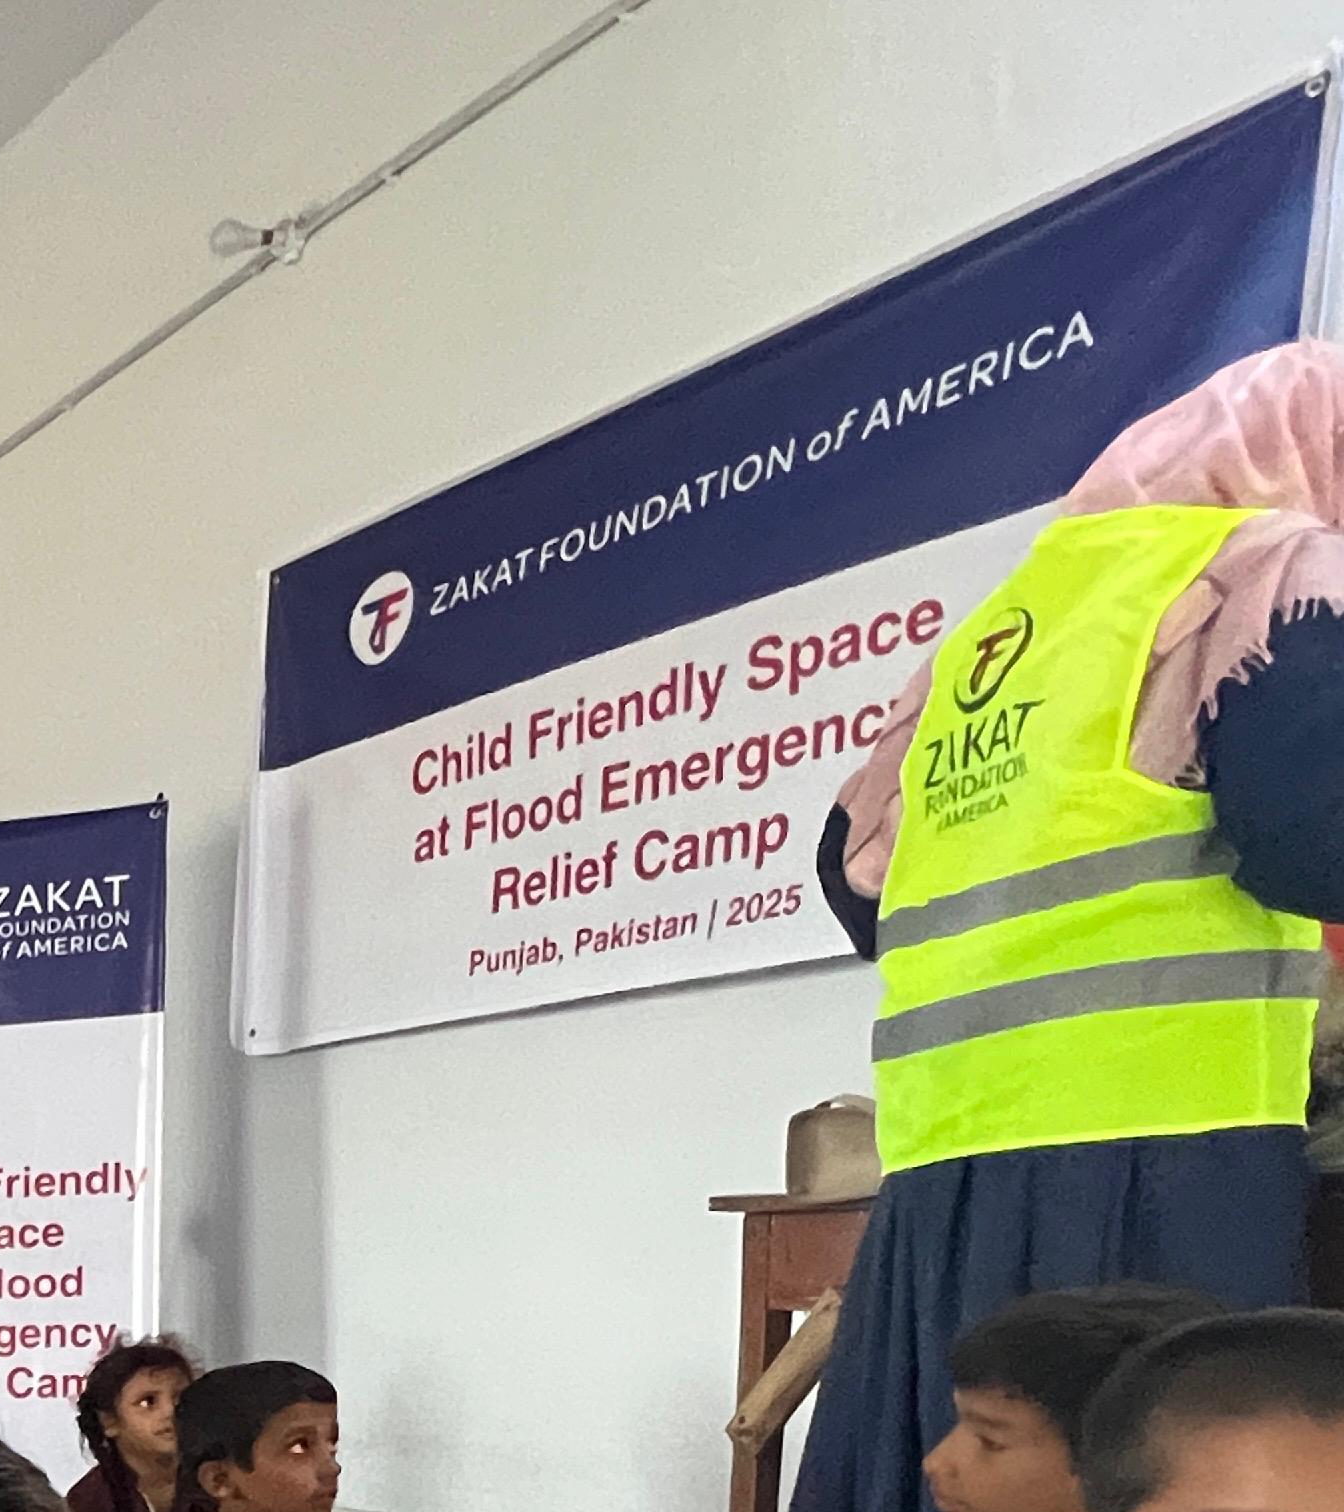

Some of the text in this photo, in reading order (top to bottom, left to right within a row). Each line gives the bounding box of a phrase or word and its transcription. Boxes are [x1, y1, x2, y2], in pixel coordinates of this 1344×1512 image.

[429, 310, 1094, 616] ZAKAT FOUNDATION of AMERICA
[412, 722, 513, 795] Child
[528, 661, 727, 760] Friendly
[746, 598, 946, 694] Space
[413, 700, 899, 863] at Flood Emergenc
[490, 812, 790, 914] Relief Camp
[15, 932, 128, 959] AMERICA
[469, 936, 565, 977] Punjab,
[575, 911, 697, 958] Pakistan
[725, 884, 804, 930] 2025
[5, 1365, 88, 1400] Cam
